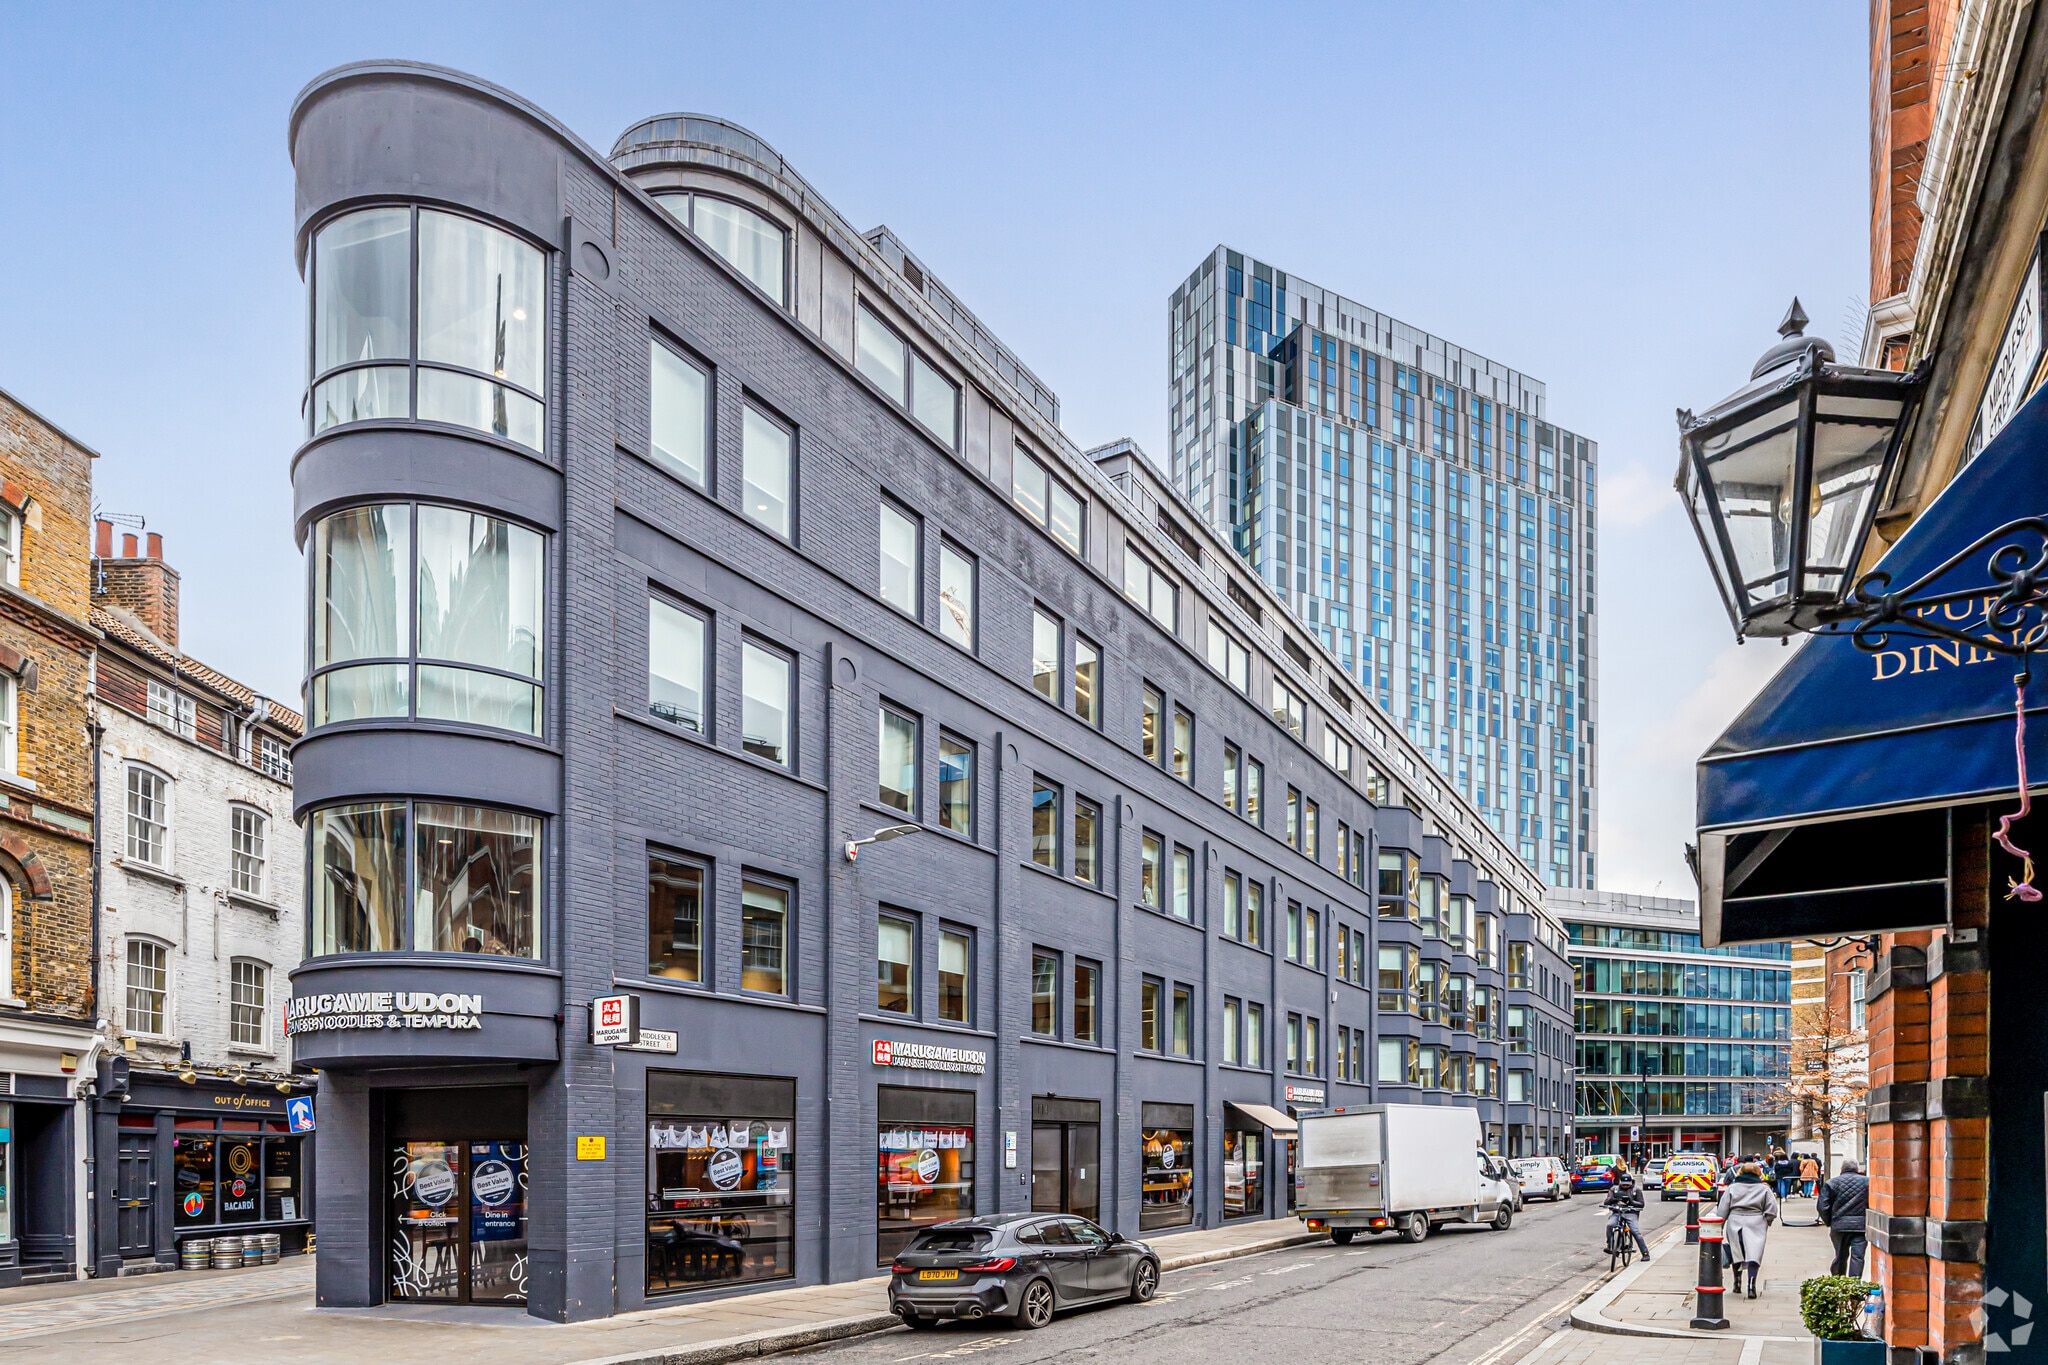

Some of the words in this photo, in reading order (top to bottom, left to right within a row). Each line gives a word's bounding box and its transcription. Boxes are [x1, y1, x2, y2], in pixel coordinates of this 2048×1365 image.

[1989, 288, 2032, 418] MIDDLESEX
[1990, 366, 2017, 438] STREET
[287, 992, 392, 1020] ARUGAME
[397, 993, 481, 1014] UDON
[388, 1014, 401, 1029] &
[405, 1014, 481, 1029] TEMPURA
[596, 1028, 628, 1036] MARUGAME
[640, 1033, 672, 1042] MIDDLESEX
[893, 1041, 958, 1062] MARUGAME
[958, 1049, 986, 1065] UDON
[214, 1096, 231, 1105] OUT
[245, 1098, 270, 1108] OFFICE
[713, 1168, 725, 1176] Best
[725, 1163, 739, 1171] Value
[419, 1181, 433, 1190] Best
[433, 1177, 451, 1186] Value
[477, 1180, 491, 1189] Best
[491, 1176, 509, 1185] Value
[224, 1198, 254, 1211] BACARDÍ
[430, 1211, 447, 1219] Click
[485, 1211, 502, 1219] Dine
[485, 1220, 516, 1228] entrance
[922, 1271, 940, 1279] LD70
[941, 1271, 956, 1279] JVH
